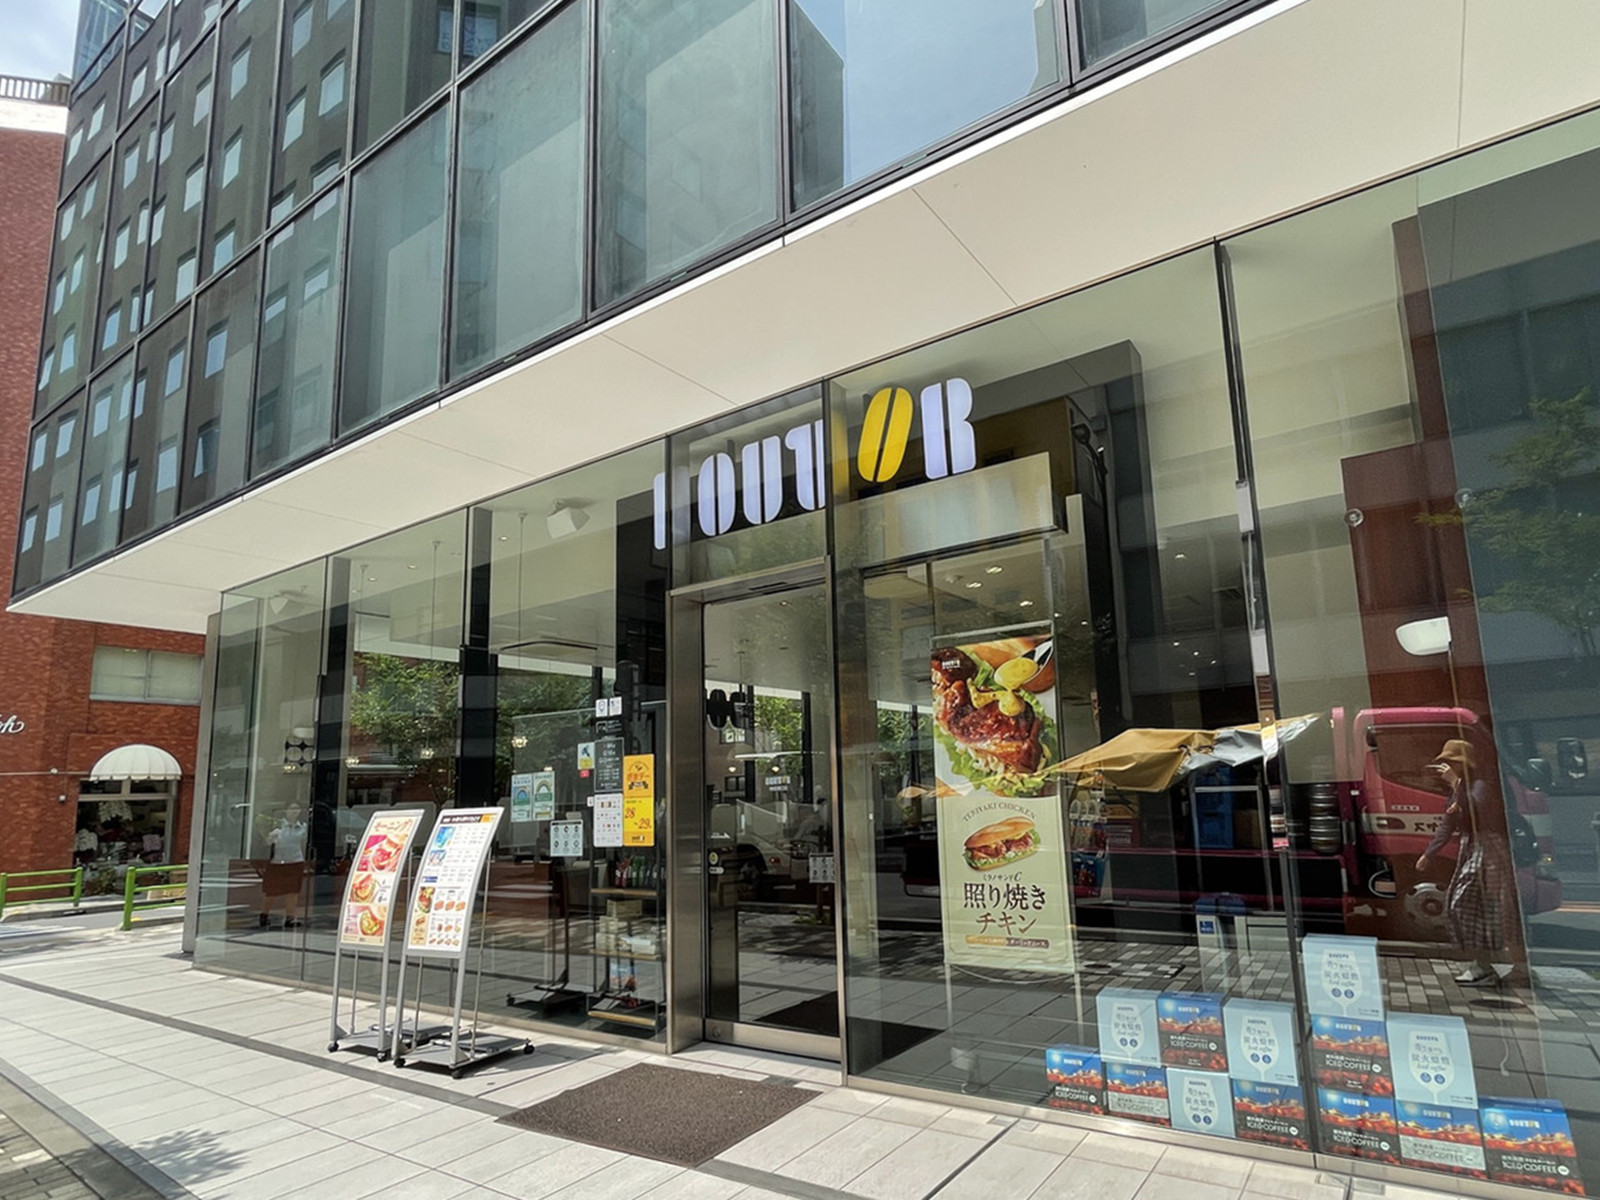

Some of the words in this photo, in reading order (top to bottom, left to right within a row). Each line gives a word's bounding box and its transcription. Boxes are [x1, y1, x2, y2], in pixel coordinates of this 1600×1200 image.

[964, 882, 1046, 911] 照り焼き
[976, 911, 1037, 935] チキン
